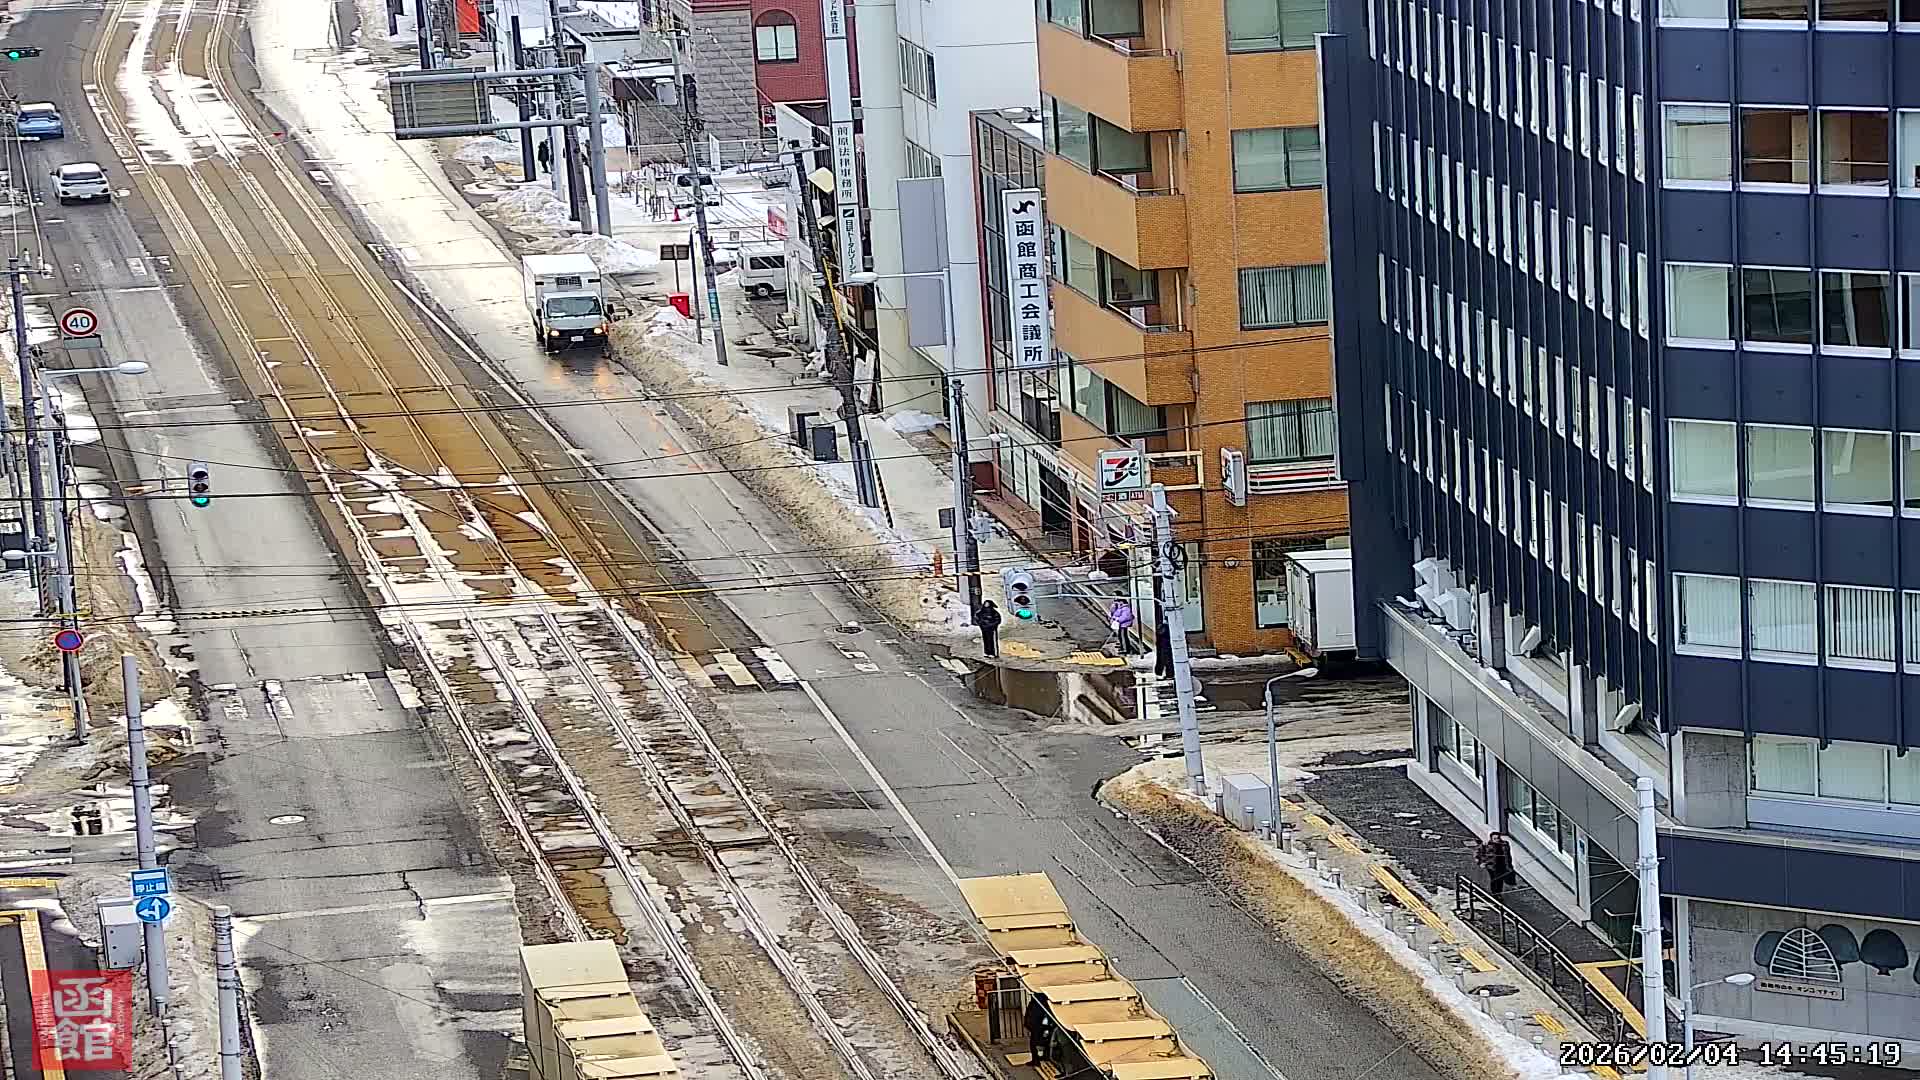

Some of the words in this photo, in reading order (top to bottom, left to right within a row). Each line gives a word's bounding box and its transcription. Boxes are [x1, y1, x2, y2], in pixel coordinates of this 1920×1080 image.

[837, 126, 852, 198] 前原法律事務所
[70, 316, 90, 328] 40
[1015, 220, 1043, 362] 函館商工会議所
